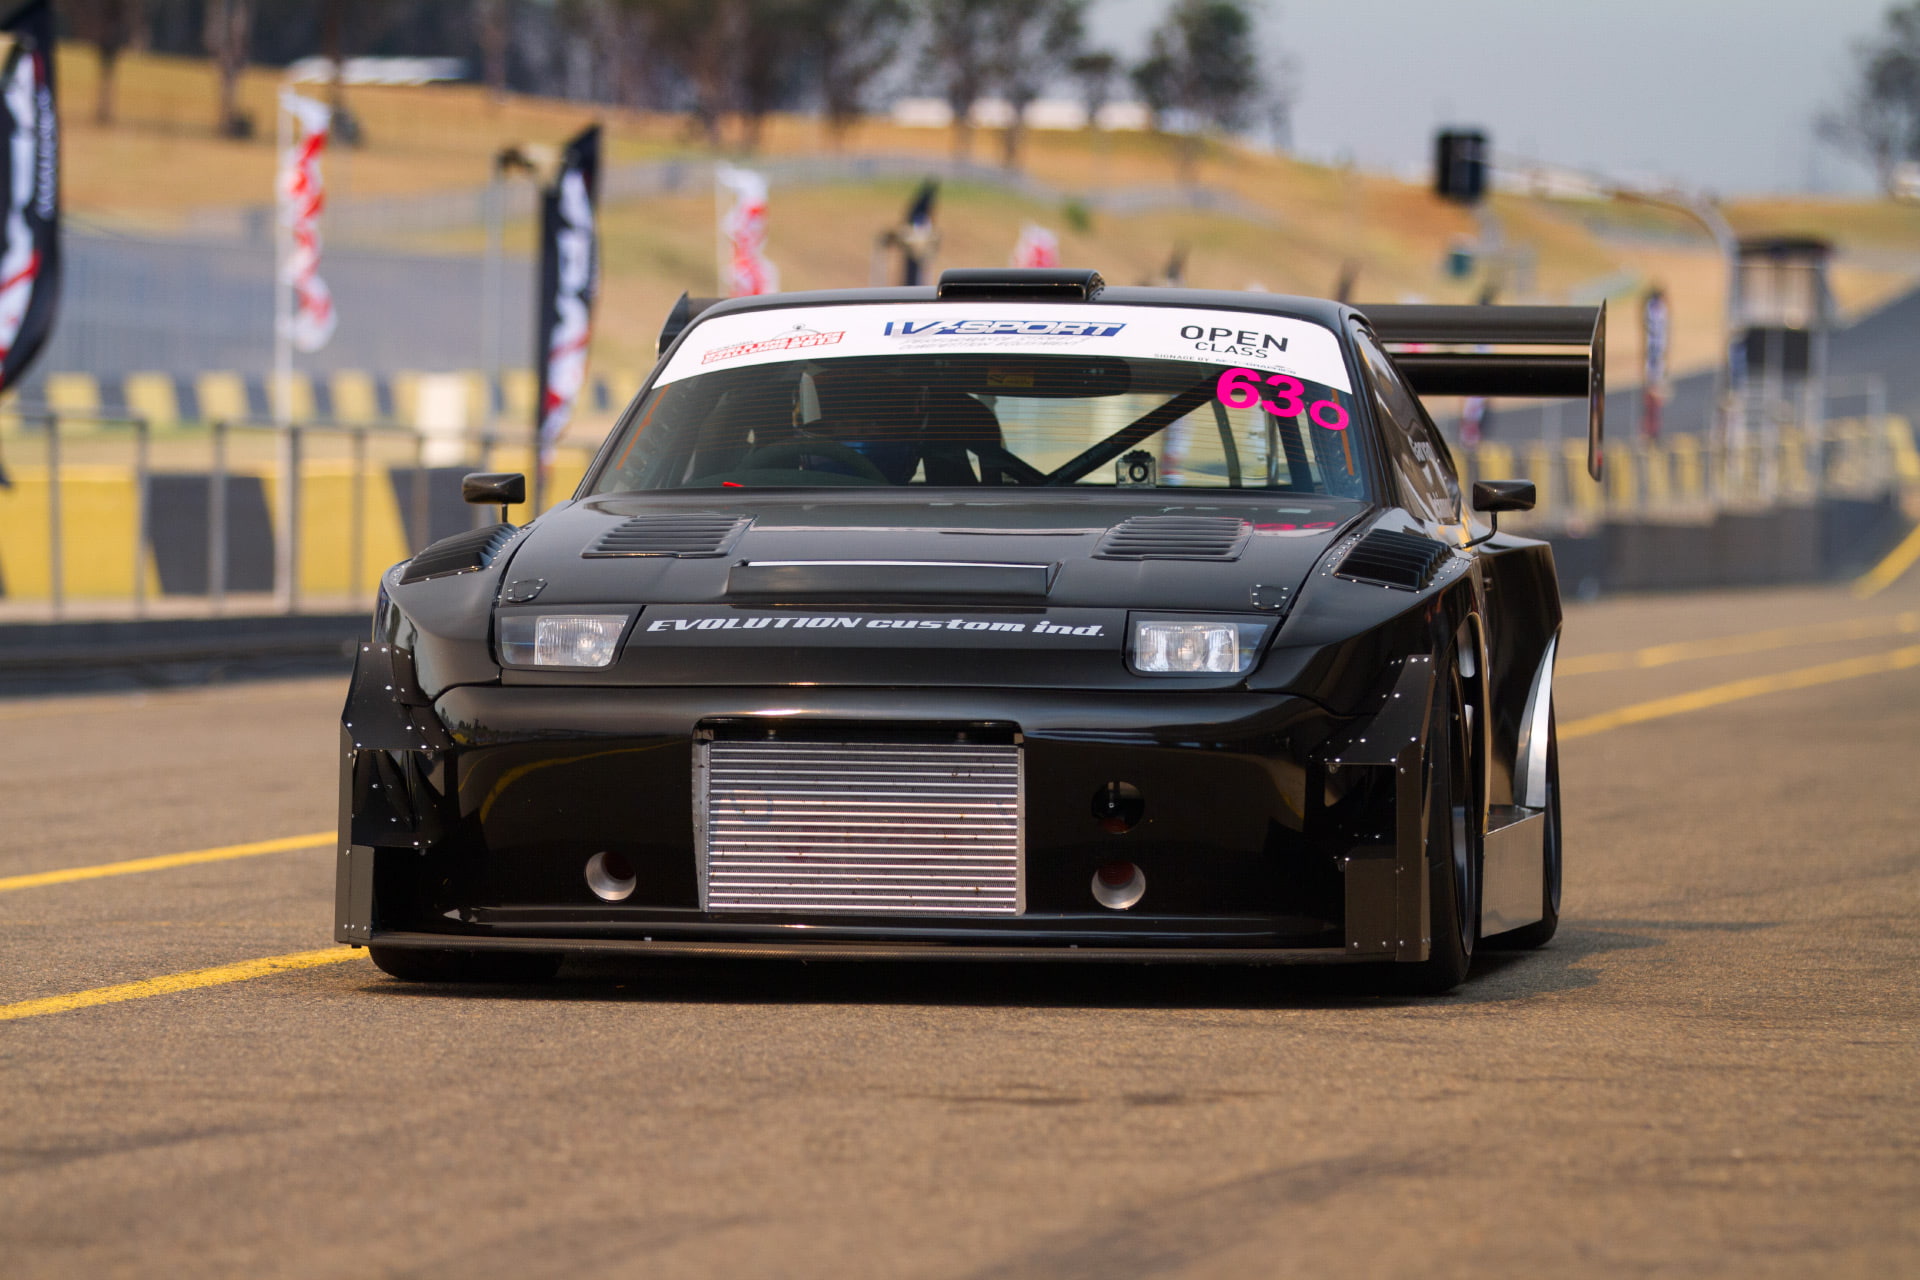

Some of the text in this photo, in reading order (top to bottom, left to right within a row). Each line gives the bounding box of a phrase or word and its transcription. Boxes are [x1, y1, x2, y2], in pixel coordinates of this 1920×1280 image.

[1180, 325, 1289, 353] OPEN
[1195, 341, 1268, 359] CLASS
[646, 617, 1105, 637] EVOLUTION custom ind.
